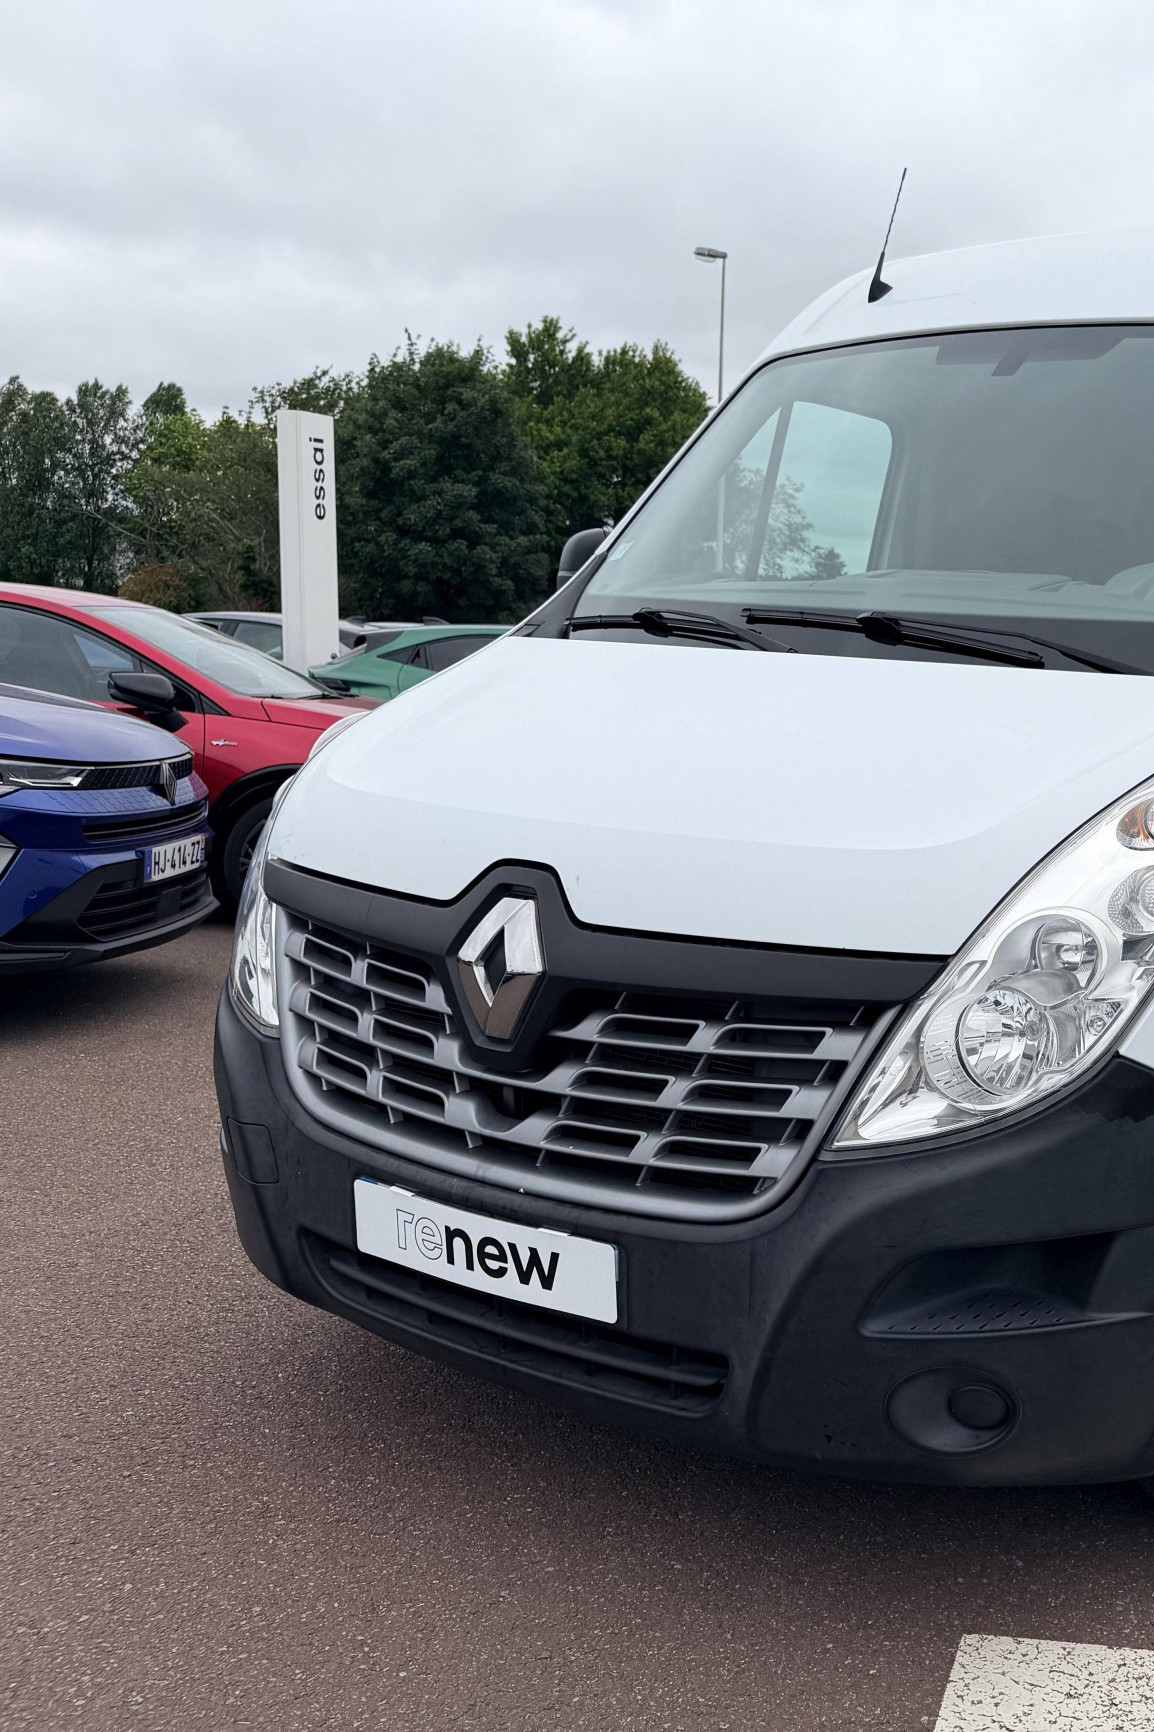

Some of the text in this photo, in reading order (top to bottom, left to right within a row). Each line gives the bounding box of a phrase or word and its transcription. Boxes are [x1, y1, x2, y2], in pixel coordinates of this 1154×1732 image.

[308, 437, 326, 521] essai
[153, 840, 201, 877] HJ-414-ZZ
[396, 1208, 560, 1291] renew
